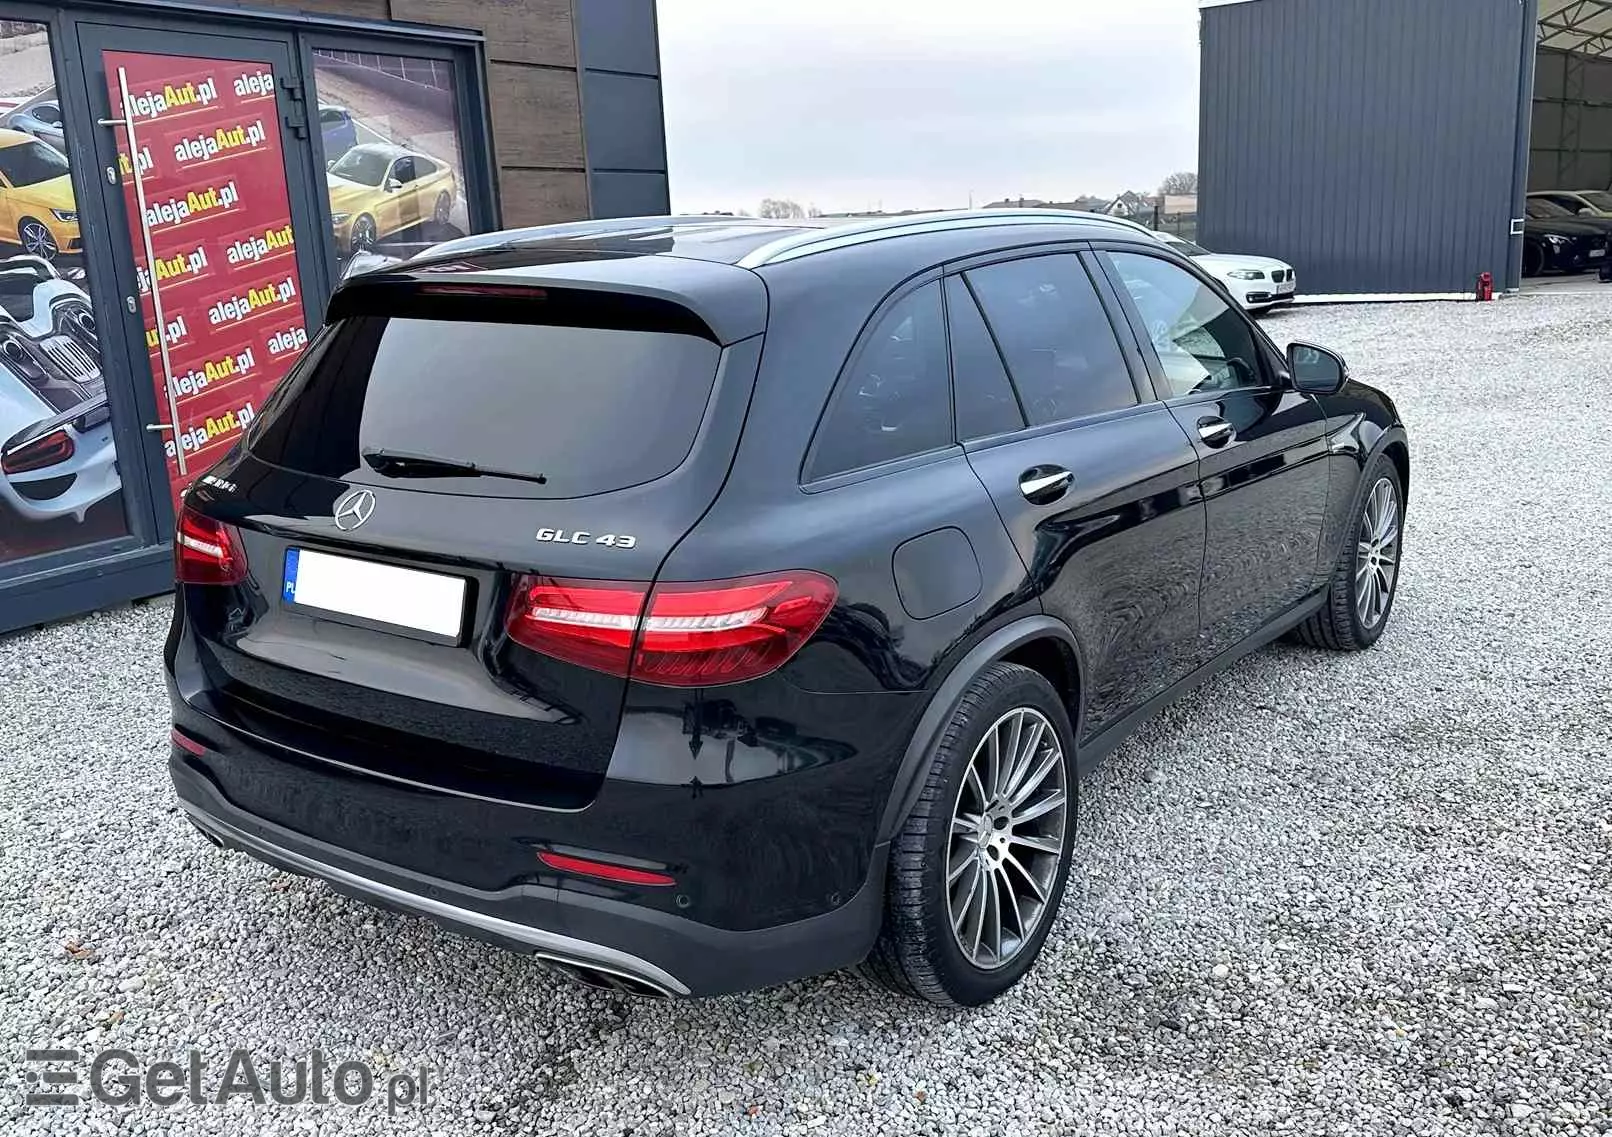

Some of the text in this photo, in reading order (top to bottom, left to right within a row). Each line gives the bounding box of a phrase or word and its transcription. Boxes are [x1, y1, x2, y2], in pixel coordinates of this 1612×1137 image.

[120, 78, 218, 118] lejaAut.pl
[174, 120, 267, 162] alejaAut.pl
[145, 181, 239, 227] alejaAut.pl
[208, 277, 297, 325] alejaAut.pl
[164, 347, 256, 400] lejaAut.pl
[164, 402, 255, 457] aejaAut.pl
[535, 527, 636, 549] GLC 43
